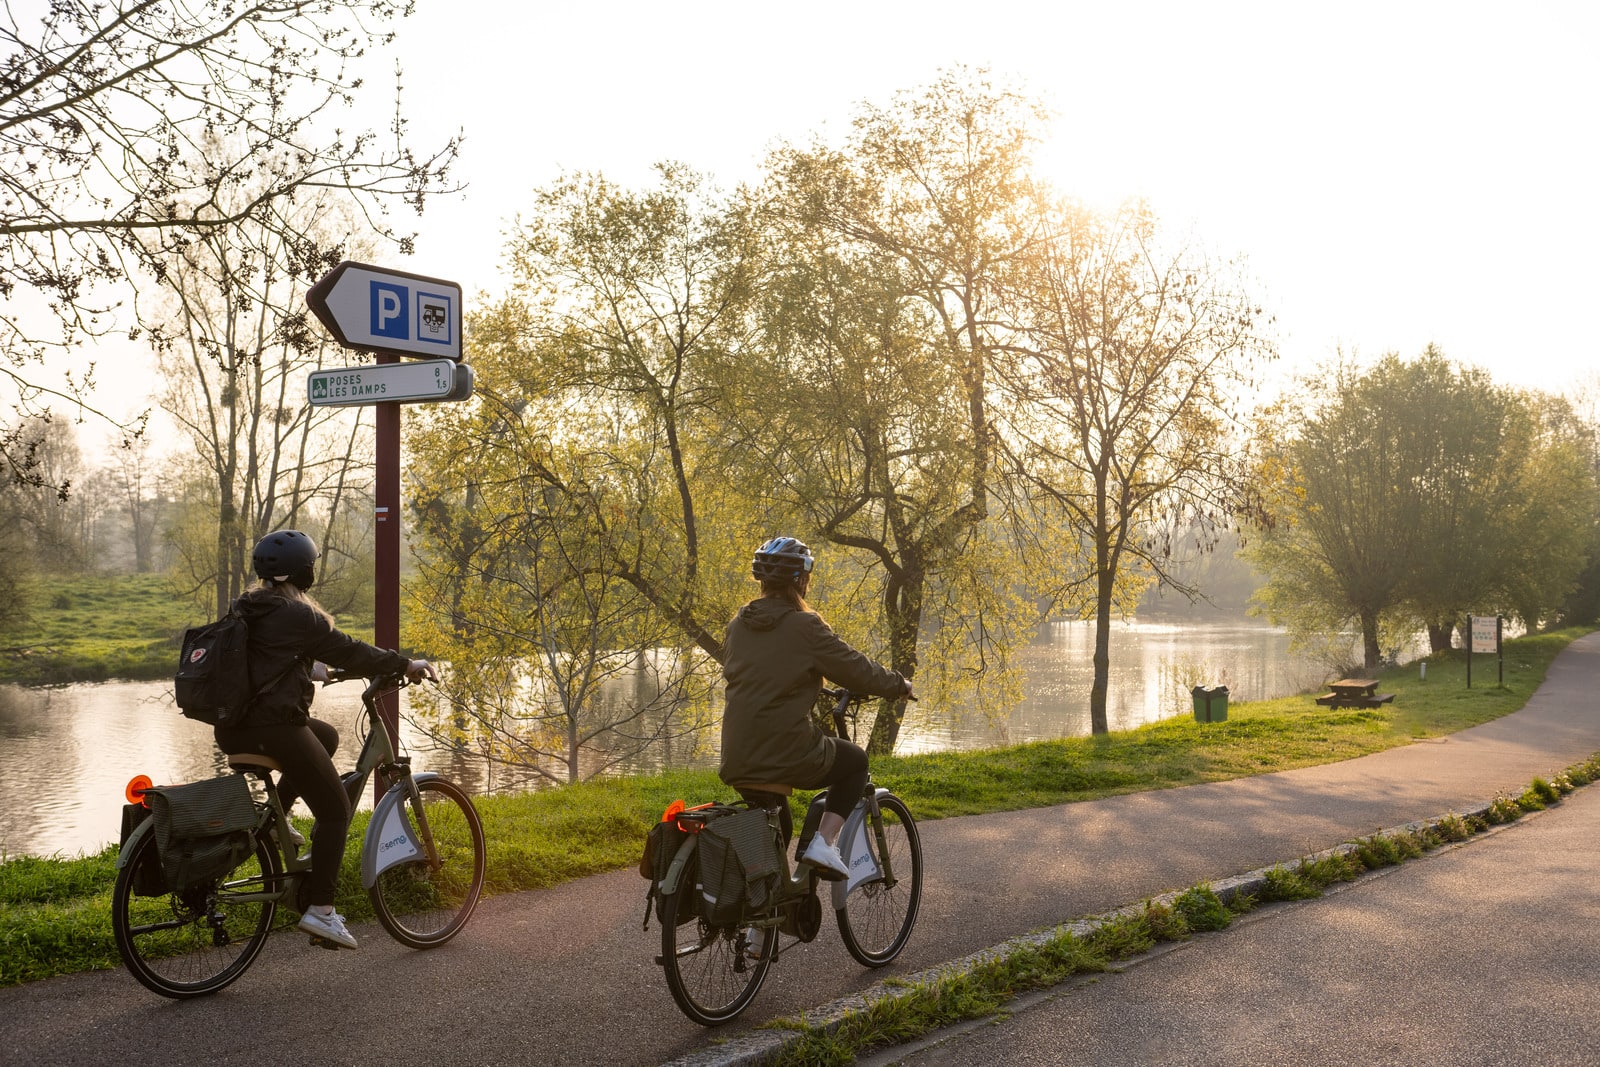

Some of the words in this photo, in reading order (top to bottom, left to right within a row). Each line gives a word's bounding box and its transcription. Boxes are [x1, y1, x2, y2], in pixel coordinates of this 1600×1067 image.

[378, 288, 401, 330] P
[329, 374, 362, 386] POSES
[434, 367, 441, 377] 8
[329, 387, 347, 398] LES
[352, 383, 386, 396] DAMPS
[436, 379, 447, 389] 1,5
